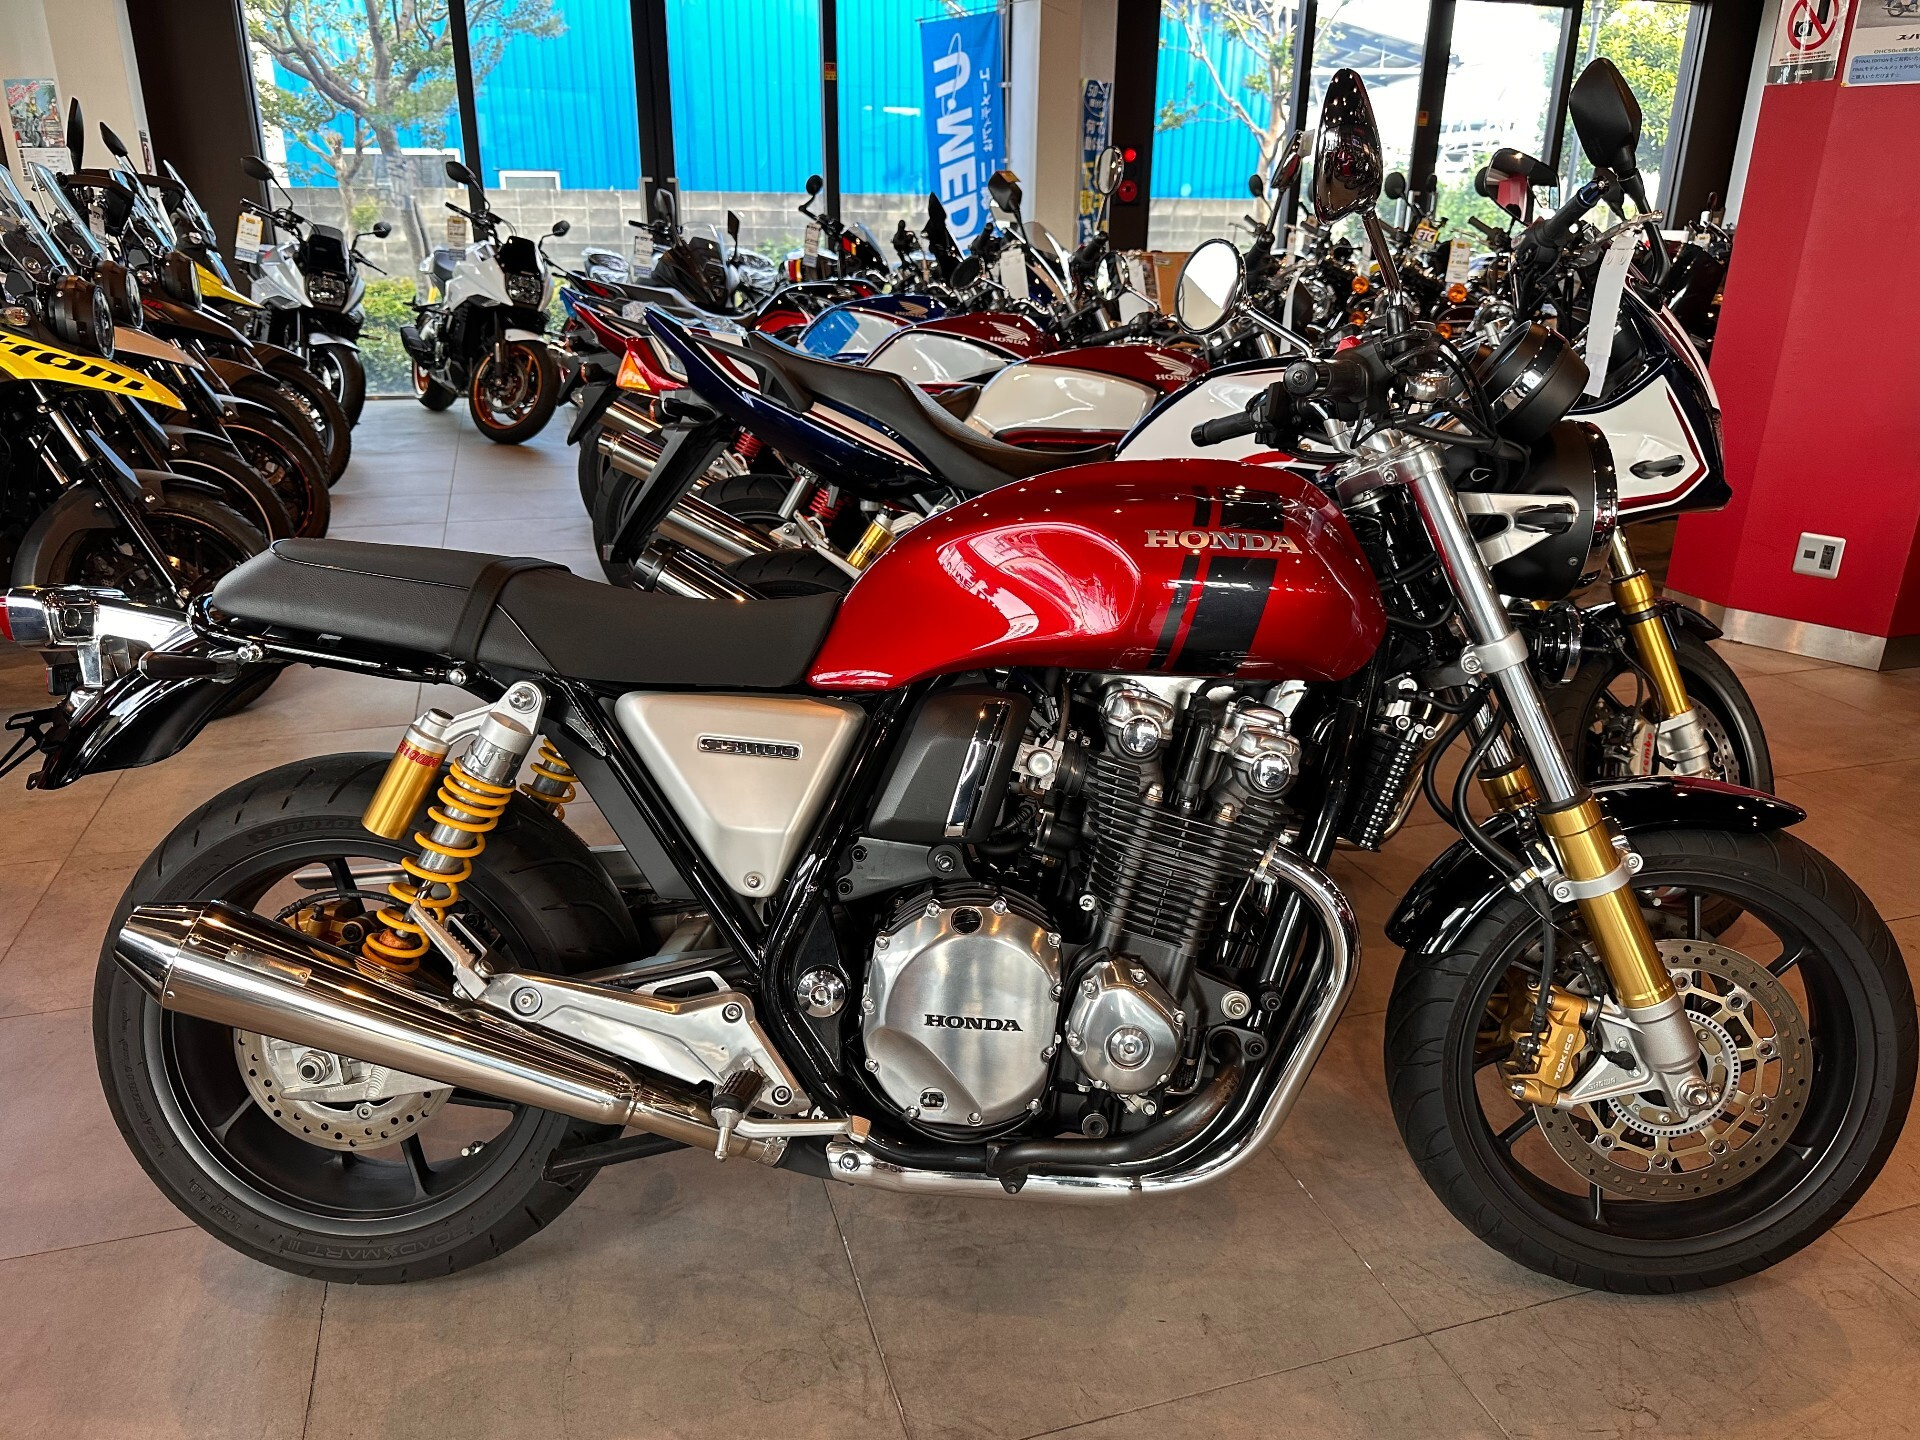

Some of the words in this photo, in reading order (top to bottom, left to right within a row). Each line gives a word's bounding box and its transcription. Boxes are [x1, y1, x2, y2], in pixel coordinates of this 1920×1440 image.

[990, 336, 1029, 347] HONDA
[1144, 530, 1302, 554] HONDA
[1643, 732, 1654, 774] rembo
[924, 1014, 1023, 1032] HONDA
[1553, 1033, 1575, 1081] TOKICO
